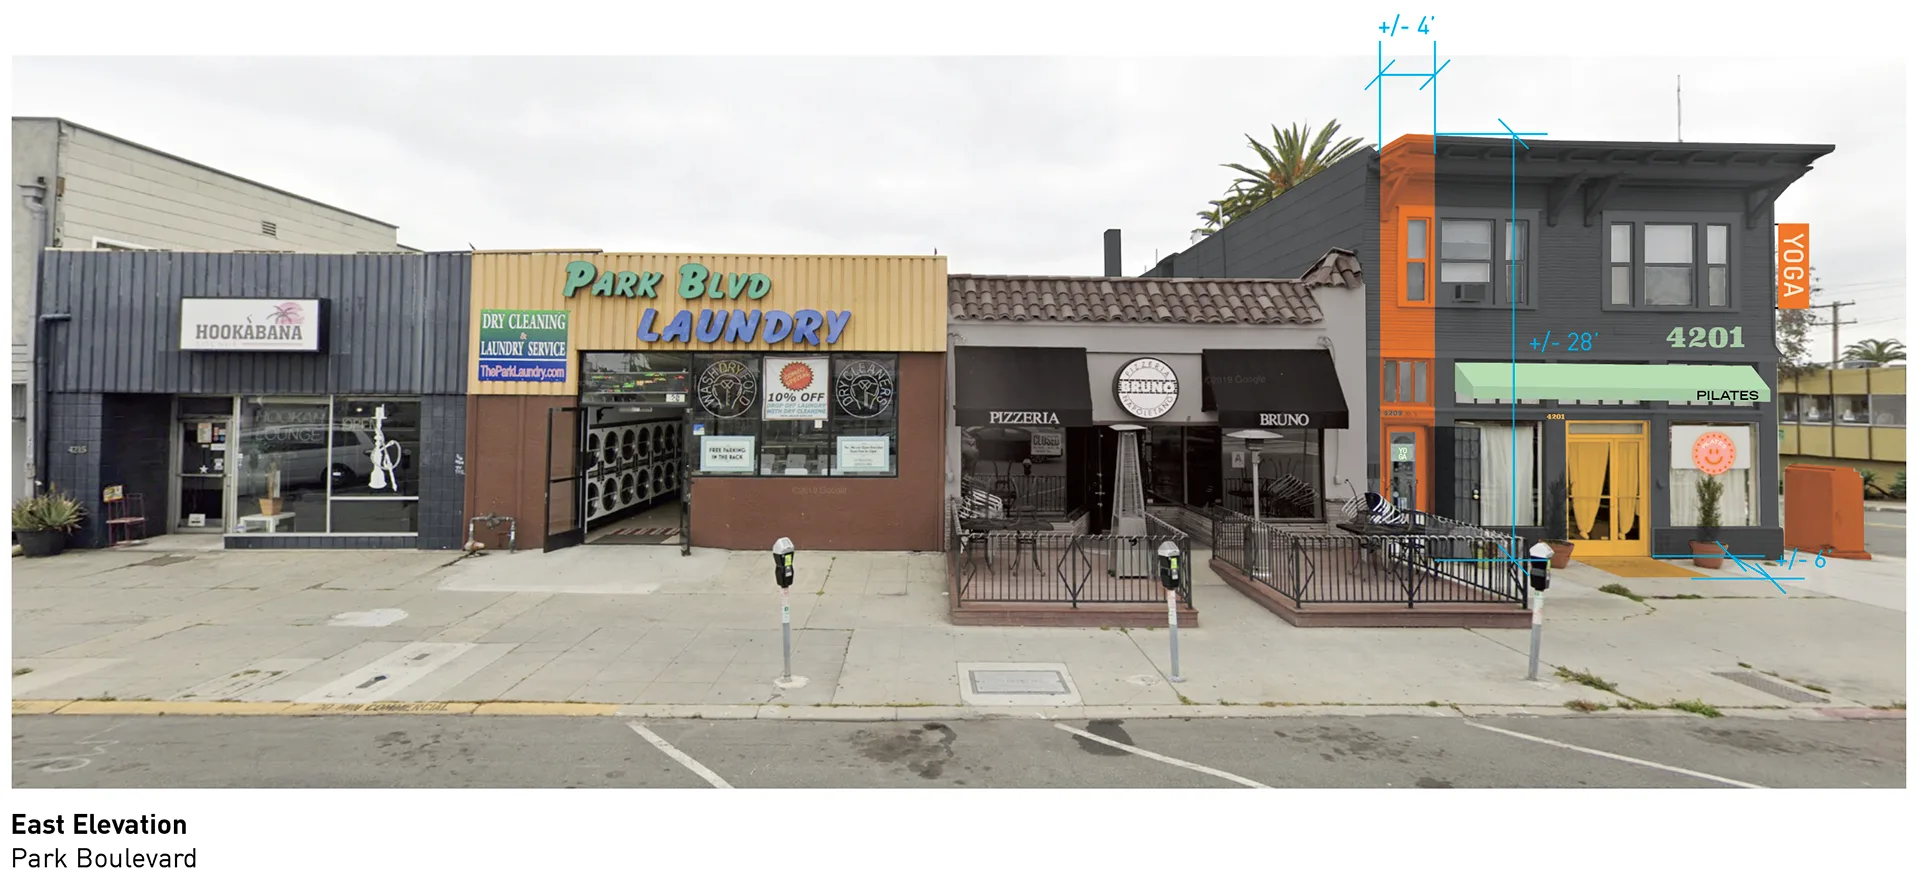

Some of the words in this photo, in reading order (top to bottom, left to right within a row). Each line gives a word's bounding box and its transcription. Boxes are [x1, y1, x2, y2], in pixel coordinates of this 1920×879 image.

[1783, 233, 1804, 298] YOGA
[482, 313, 505, 329] DRY
[508, 313, 566, 330] CLEANING
[636, 308, 852, 346] LAUNDRY
[520, 332, 527, 340] &
[1666, 326, 1745, 348] 4201
[481, 340, 524, 356] LAUNDRY
[528, 341, 566, 357] SERVICE
[480, 365, 565, 380] TheParkLaundry.com
[1125, 361, 1170, 377] PIZZERIA
[701, 366, 719, 407] WASH
[719, 362, 744, 374] DRY
[740, 372, 755, 406] FOLD
[1121, 381, 1175, 393] BRUNO
[768, 393, 796, 402] 10%
[801, 393, 825, 402] OFF
[1696, 390, 1759, 401] PILATES
[1122, 396, 1174, 416] NAPOLETANO
[256, 410, 326, 424] HOOKAH
[989, 411, 1060, 425] PIZZERIA
[1260, 413, 1310, 426] BRUNO
[256, 427, 321, 442] LOUNGE
[1033, 435, 1060, 446] CLOSED
[1701, 438, 1727, 450] PILATES
[1234, 454, 1242, 462] A
